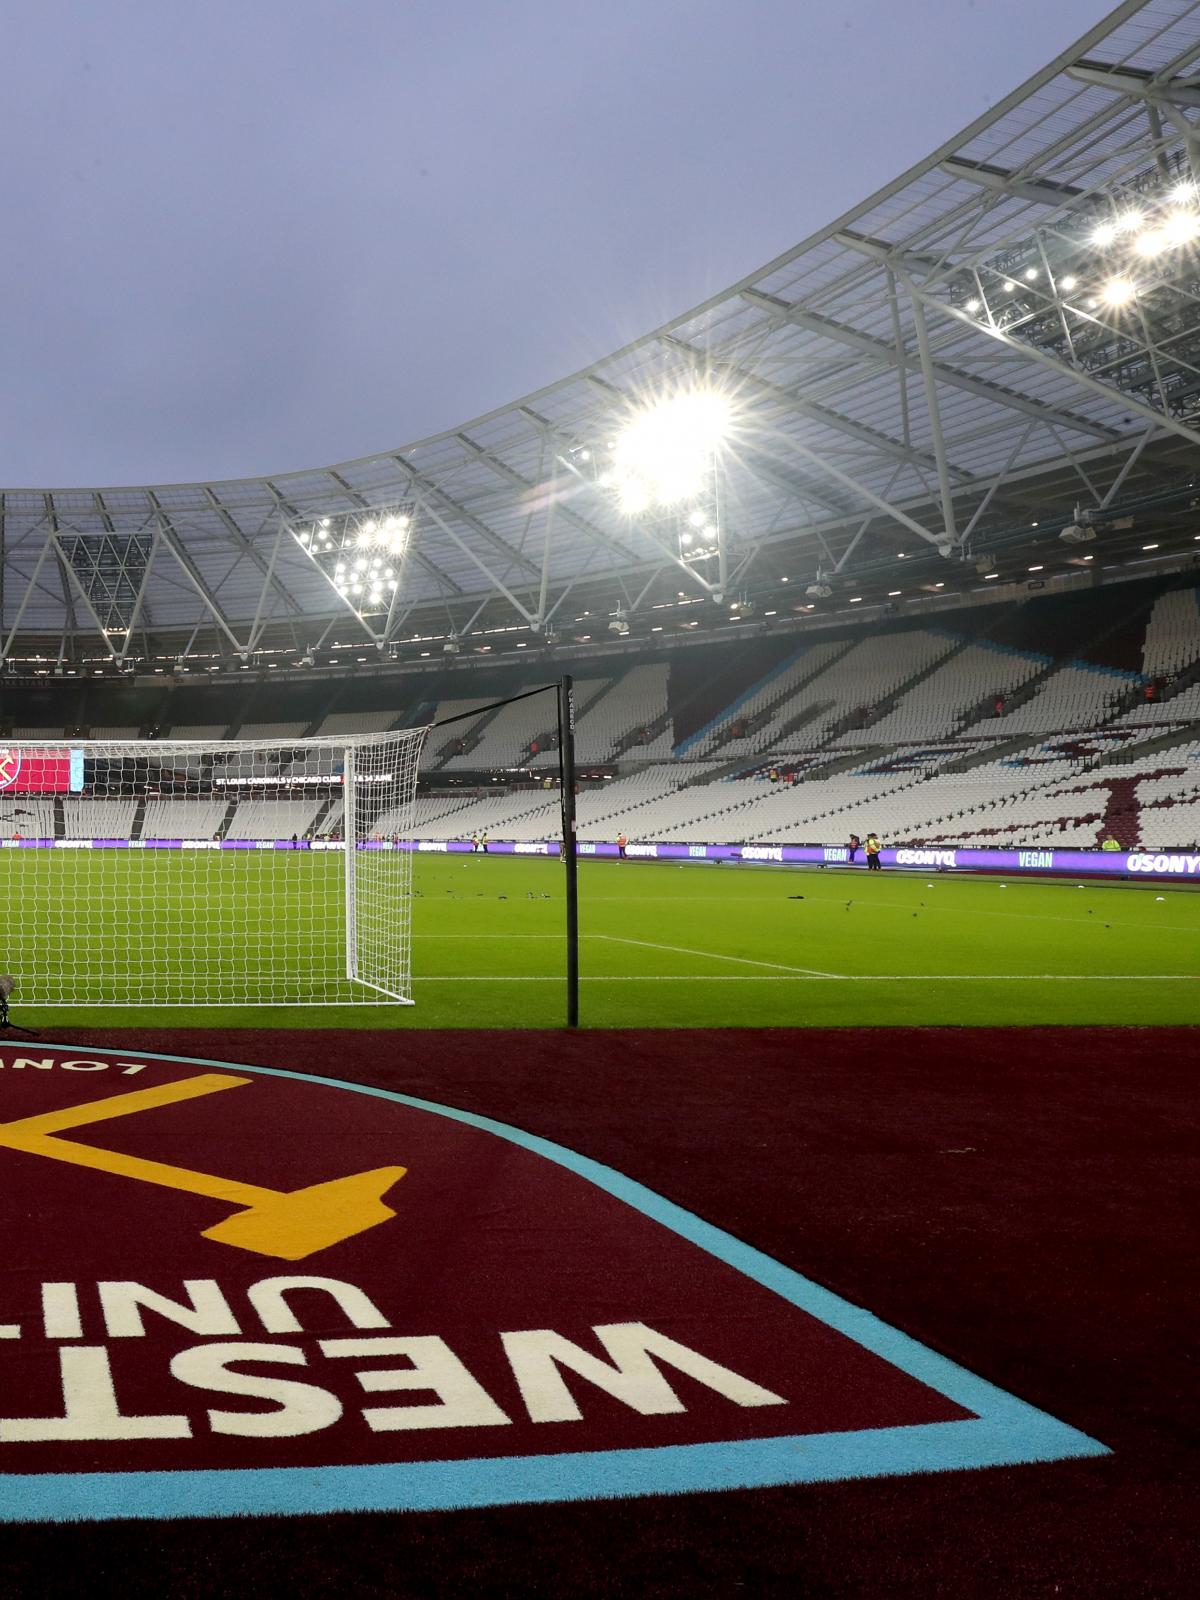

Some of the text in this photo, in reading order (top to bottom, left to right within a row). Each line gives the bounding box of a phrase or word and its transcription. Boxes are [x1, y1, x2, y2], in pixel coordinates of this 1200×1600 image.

[227, 777, 247, 785] LOUIS
[247, 777, 285, 785] CARDINALS
[292, 776, 321, 784] CHICAGO
[323, 775, 341, 783] CUBS
[689, 845, 706, 857] VEGAN
[824, 848, 847, 861] VEGAN
[1019, 851, 1052, 868] VEGAN
